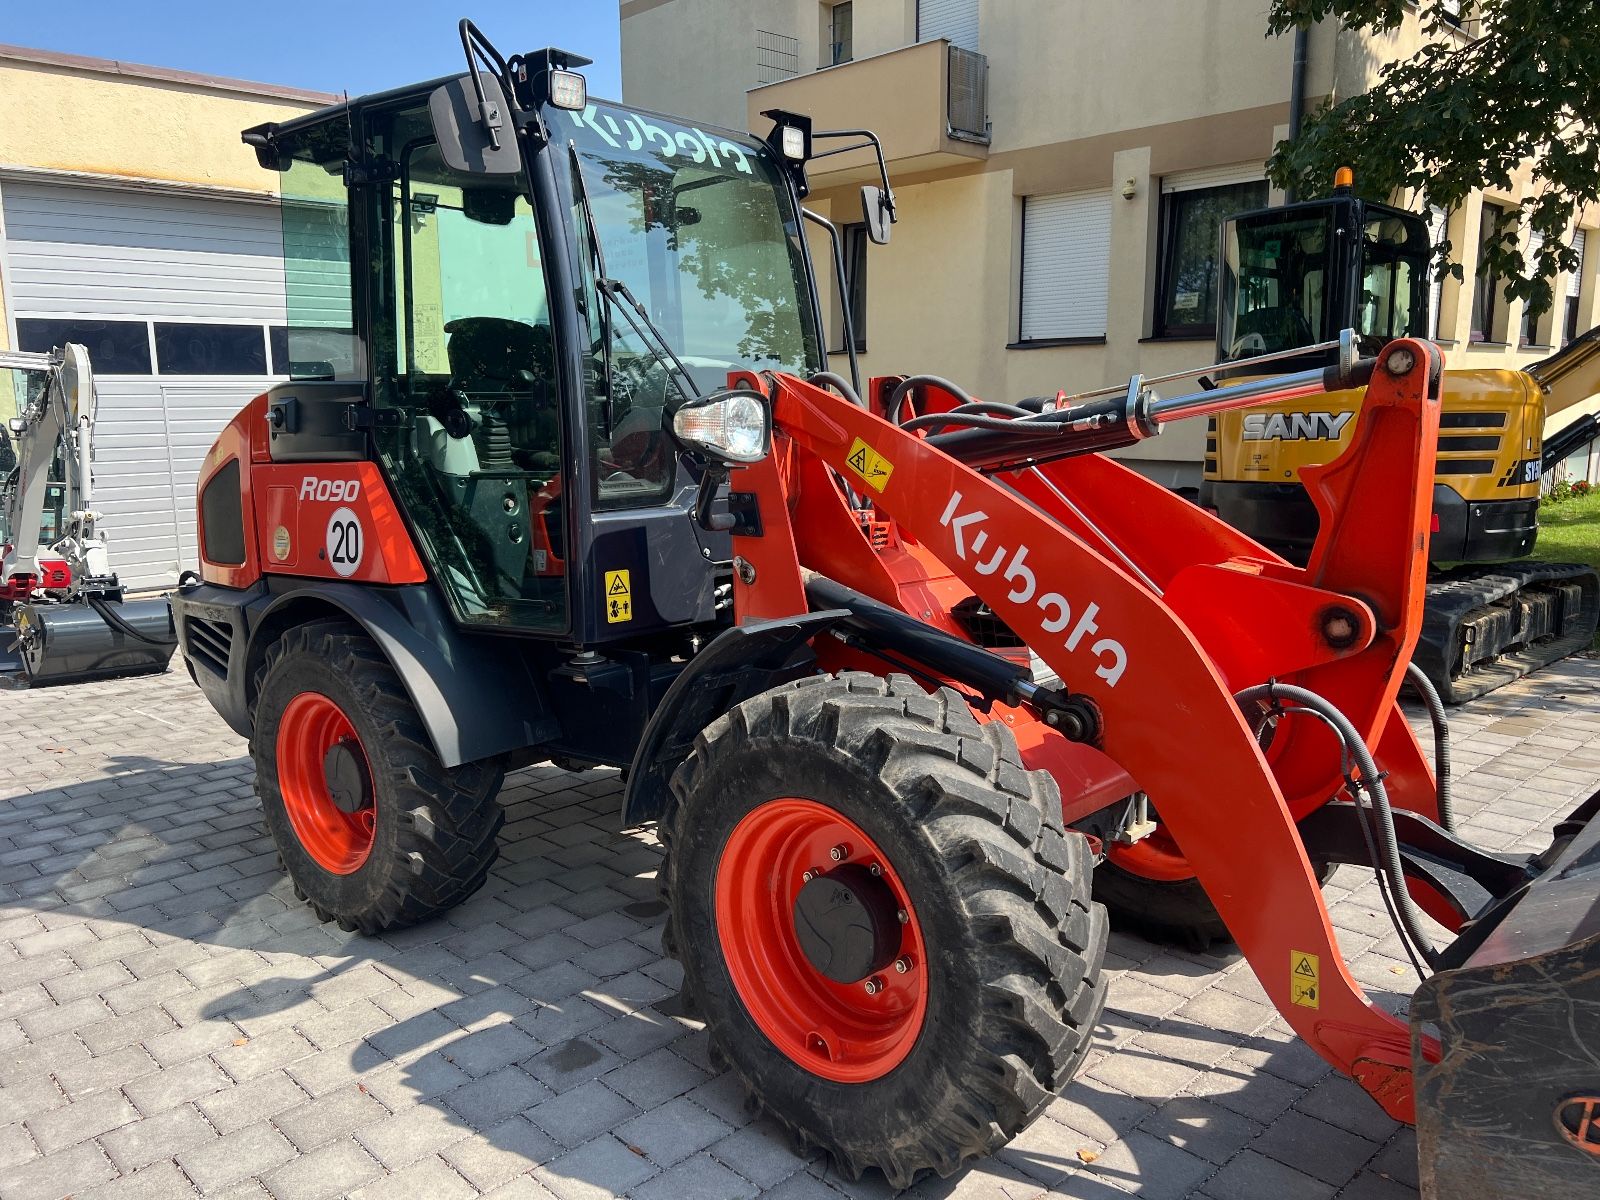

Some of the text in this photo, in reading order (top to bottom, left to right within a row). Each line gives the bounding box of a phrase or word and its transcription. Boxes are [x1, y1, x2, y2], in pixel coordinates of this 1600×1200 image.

[568, 104, 752, 174] Kubota
[1243, 412, 1355, 440] SANY
[300, 476, 360, 502] R090
[332, 520, 359, 564] 20
[939, 490, 1128, 688] Kubota
